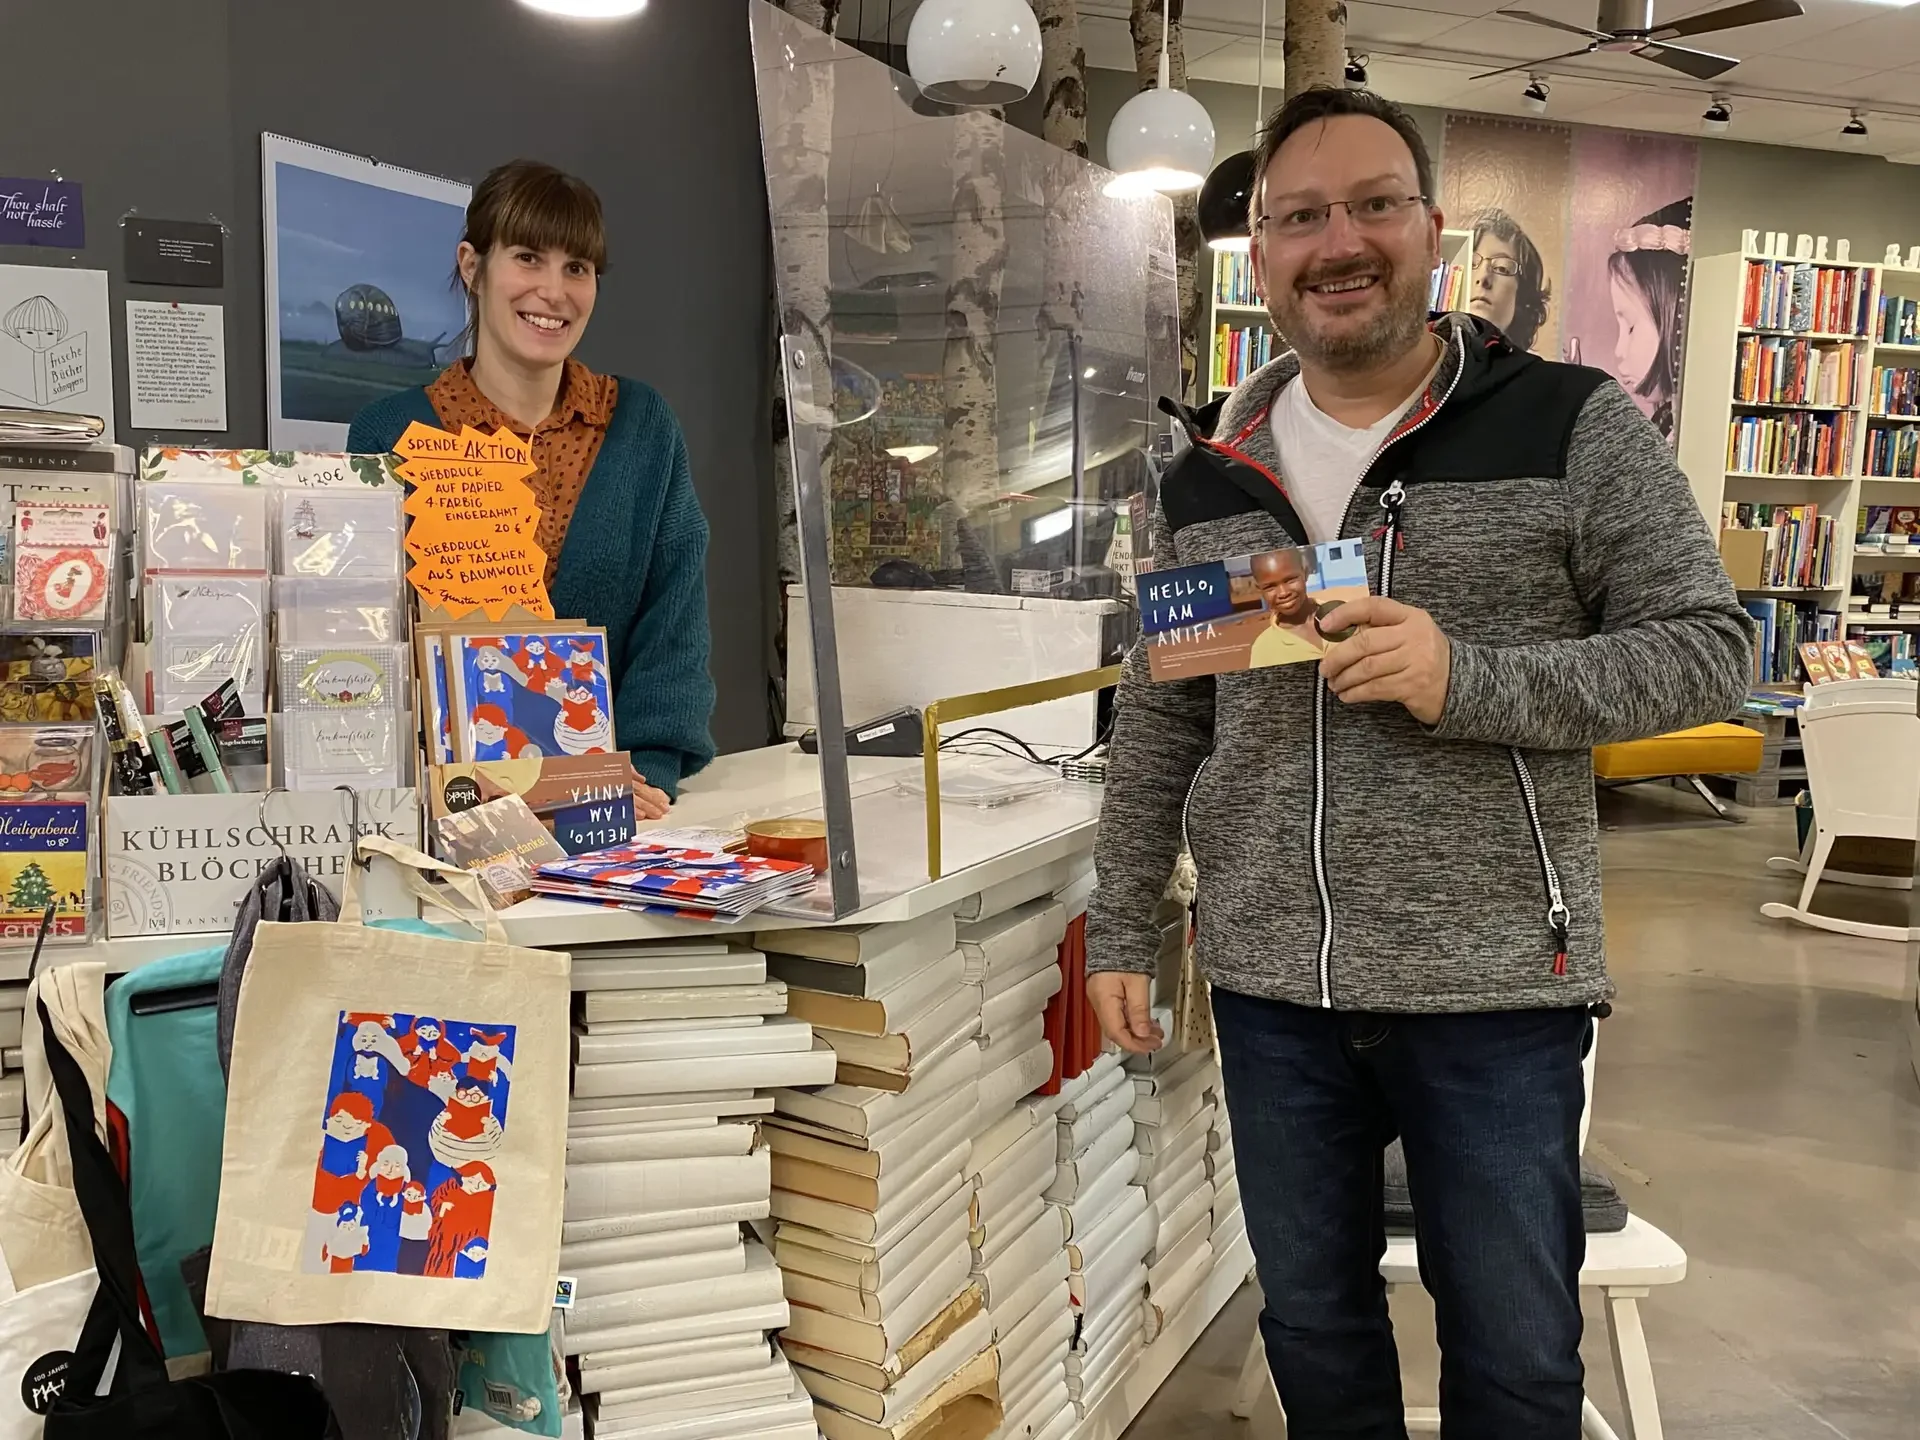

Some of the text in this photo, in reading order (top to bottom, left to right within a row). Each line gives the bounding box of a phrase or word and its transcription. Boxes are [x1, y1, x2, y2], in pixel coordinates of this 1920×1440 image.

[0, 192, 30, 214] Thou
[6, 211, 66, 228] not hassle
[50, 346, 83, 369] frische
[51, 364, 83, 384] Bücher
[420, 467, 483, 481] SIEBDRUCK
[435, 479, 504, 493] AUF PAPIER
[446, 507, 519, 521] EINGERAHMT
[494, 524, 522, 534] 20 €
[424, 539, 490, 556] SIEBDRUCK
[440, 550, 526, 565] AUF TASCHEN
[428, 564, 536, 584] AUS BAUMWOLLE
[501, 584, 528, 595] 10 €
[1149, 579, 1213, 601] HELLO,
[1153, 603, 1193, 624] I AM
[1157, 623, 1222, 648] ANIFA.
[316, 729, 376, 744] Einkaufsliste
[565, 783, 624, 804] ANIFA.
[589, 805, 626, 823] I AM
[0, 816, 79, 840] Heiligabend
[569, 826, 627, 845] HELLO,
[46, 837, 69, 847] to go
[517, 834, 549, 855] danke!
[34, 1373, 46, 1383] 100
